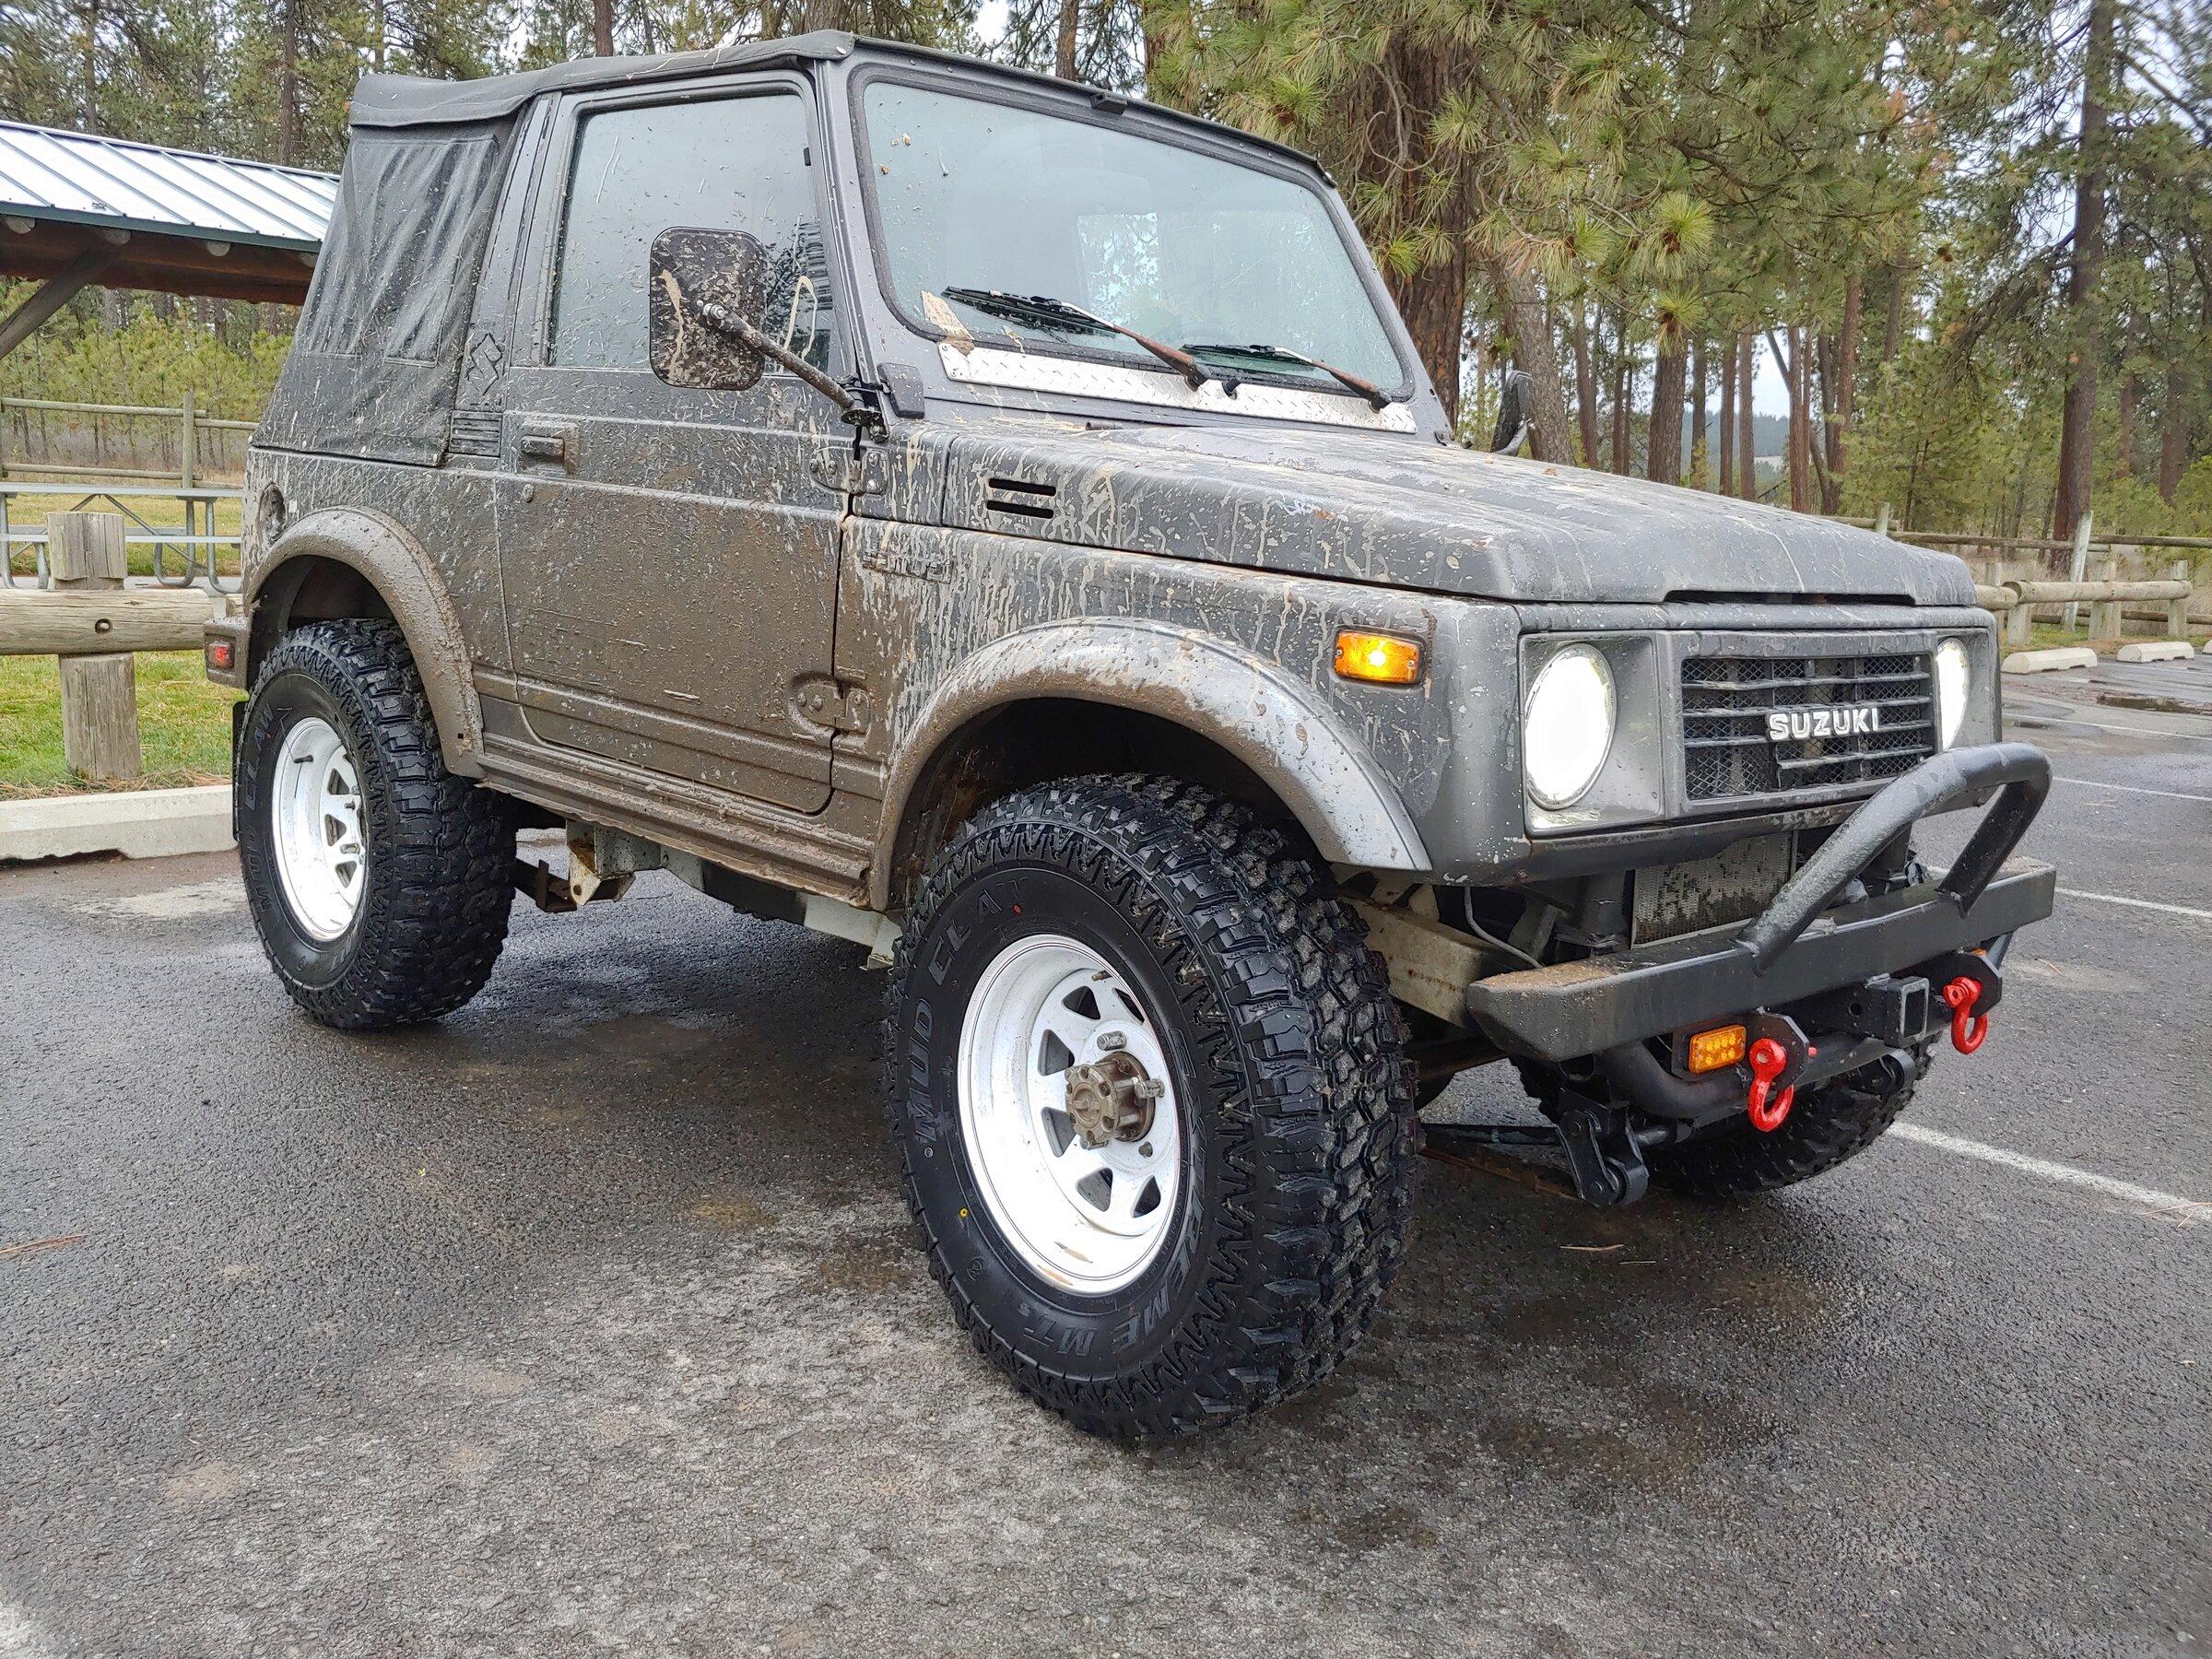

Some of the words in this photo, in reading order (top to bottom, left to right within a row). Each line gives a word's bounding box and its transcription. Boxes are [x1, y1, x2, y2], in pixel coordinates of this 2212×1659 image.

[244, 702, 274, 811] CLAW
[1769, 708, 1879, 741] SUZUKI
[246, 827, 273, 912] MUD
[906, 998, 937, 1143] MUD
[1112, 1029, 1205, 1355] EXTREME
[1023, 1314, 1099, 1357] MT
